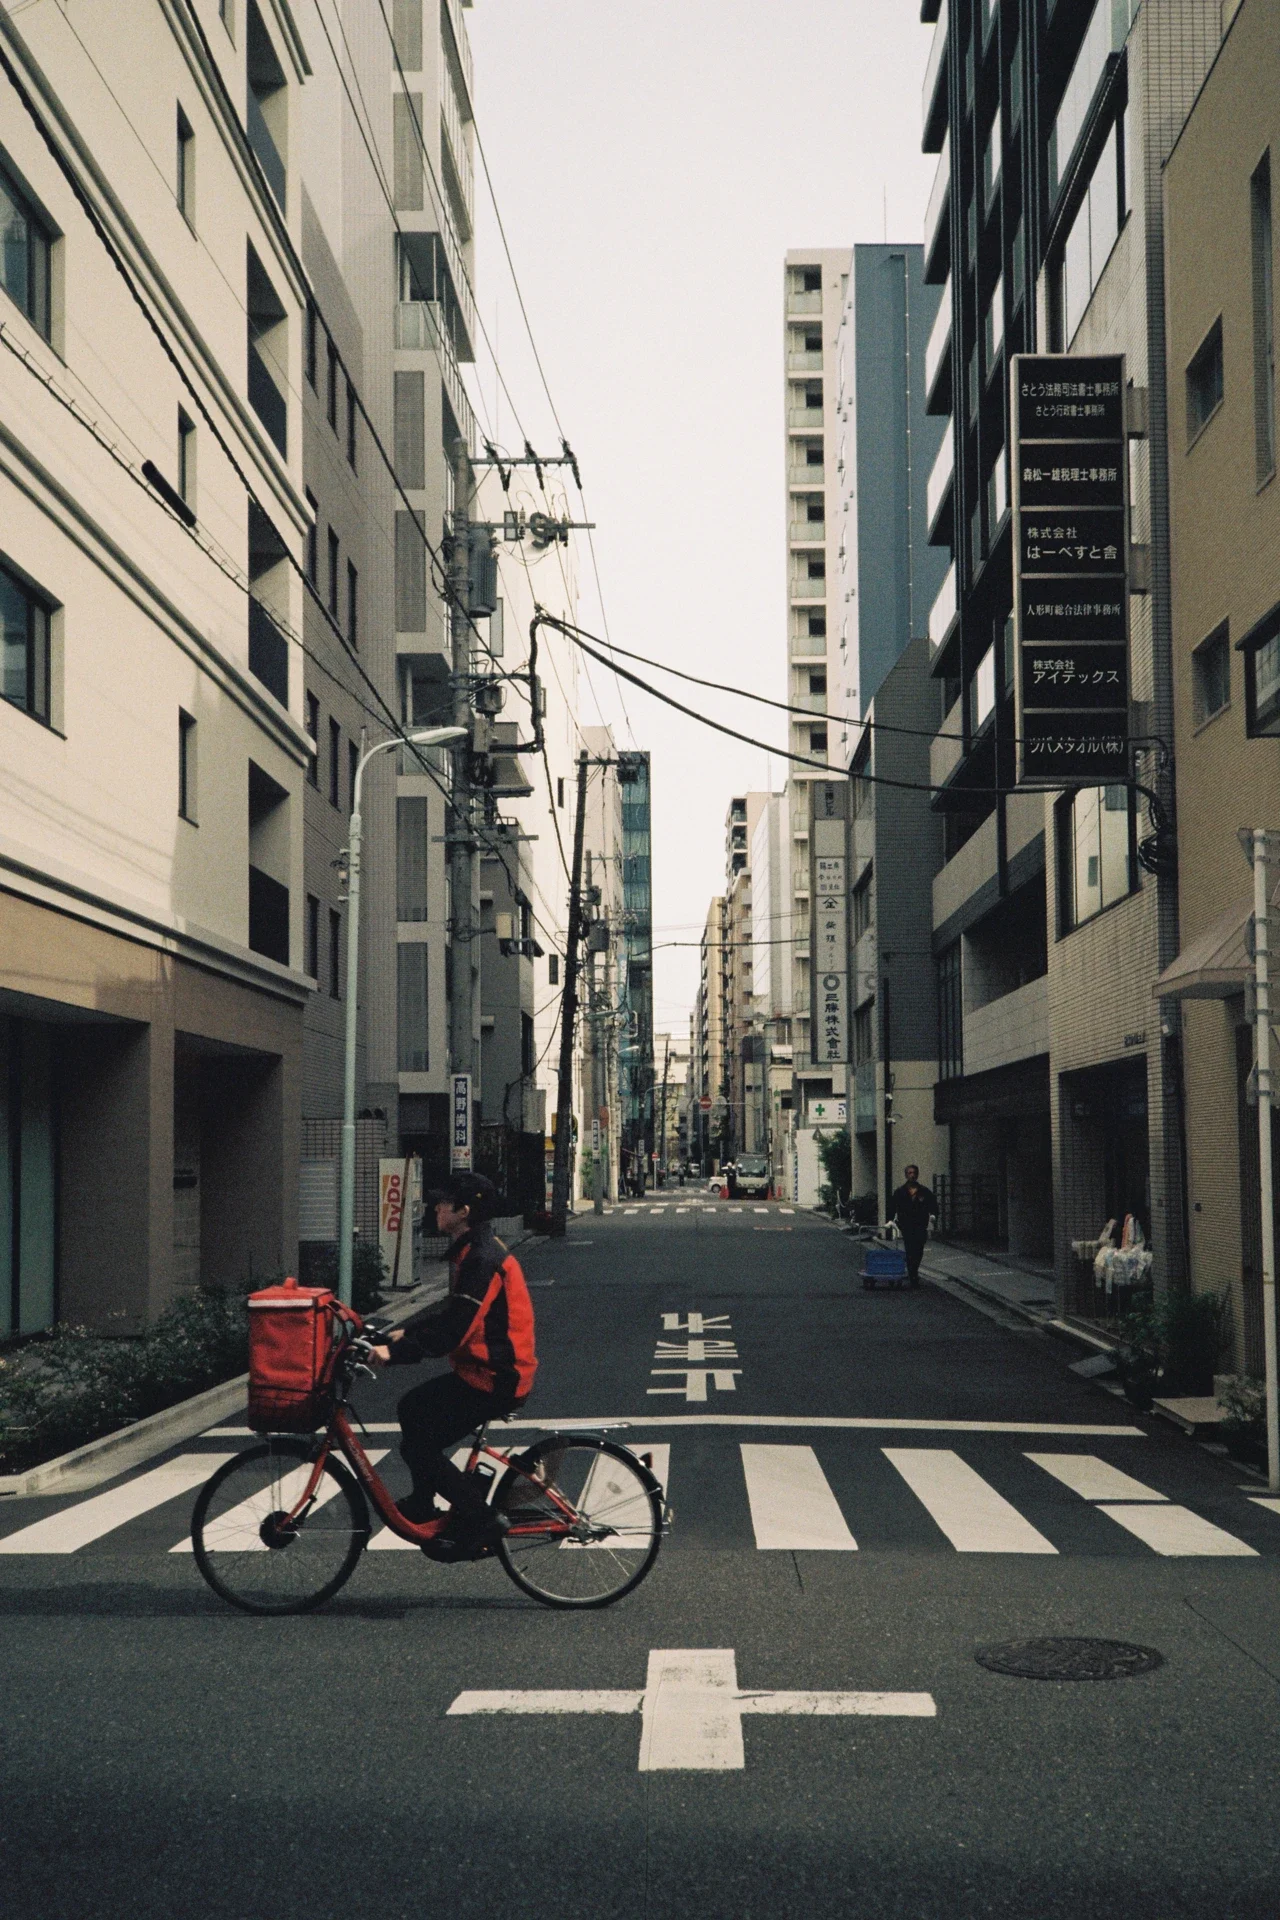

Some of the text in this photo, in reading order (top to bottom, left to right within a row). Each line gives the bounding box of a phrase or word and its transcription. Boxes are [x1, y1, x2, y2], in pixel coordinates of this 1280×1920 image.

[1021, 382, 1119, 397] さとう法務司法書士事務所
[1036, 404, 1105, 417] さとう行政書士事務所
[1023, 467, 1117, 482] 森松一雄税理士事務所
[1027, 527, 1077, 539] 株式会社
[1027, 544, 1118, 560] はーべすと舎
[1027, 604, 1121, 616] 人形町総合法律事務所
[1033, 659, 1075, 670] 株式会社
[1033, 670, 1120, 684] アイテックス
[456, 1081, 467, 1143] 高野歯科
[387, 1174, 403, 1232] DyDo
